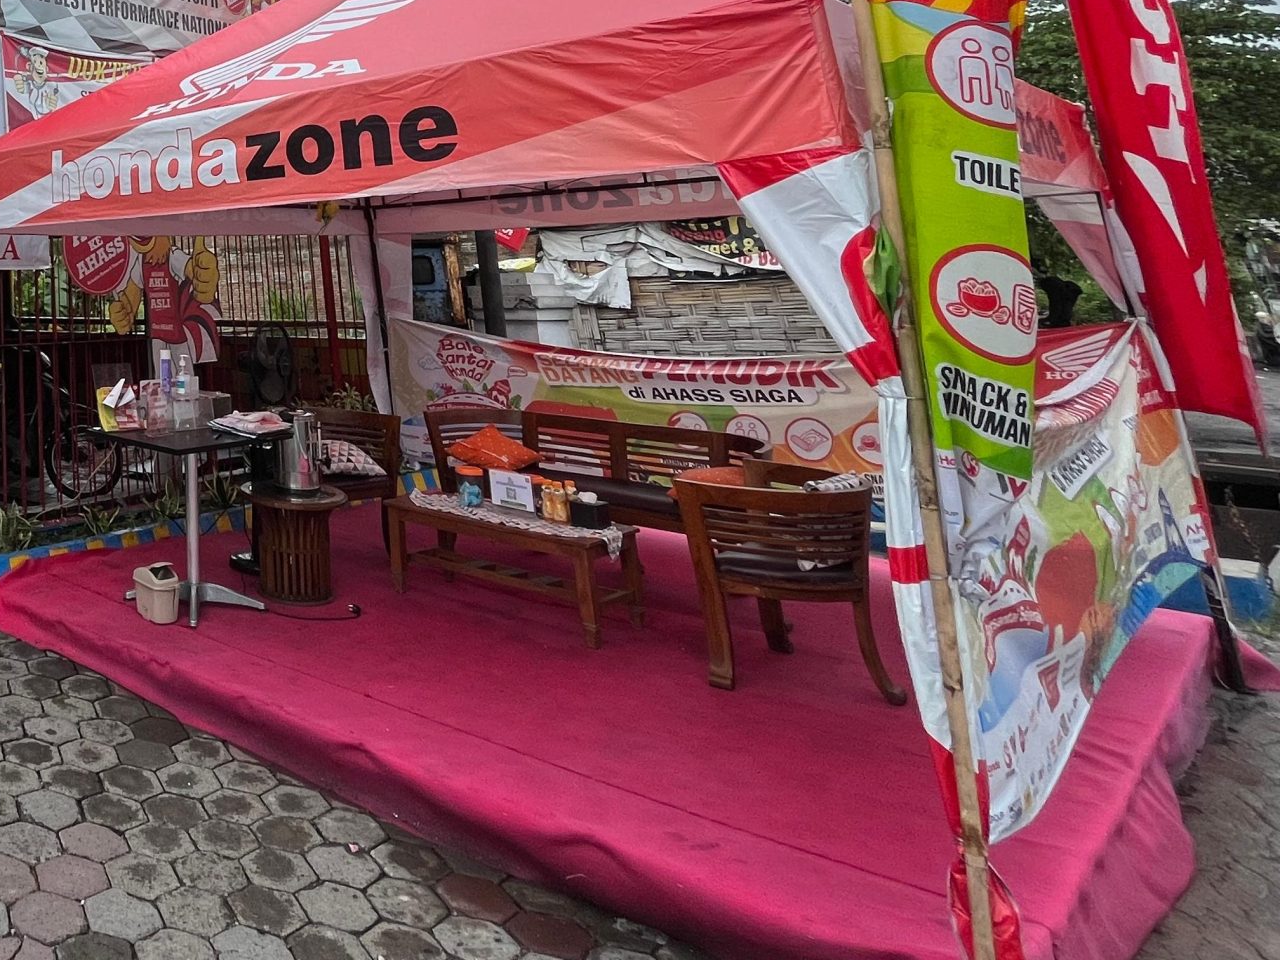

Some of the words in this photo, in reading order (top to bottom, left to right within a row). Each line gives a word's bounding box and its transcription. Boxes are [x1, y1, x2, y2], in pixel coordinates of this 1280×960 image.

[131, 58, 368, 120] HONDA
[50, 105, 459, 204] hondazone
[954, 155, 1020, 193] TOILE
[76, 237, 125, 280] AHASS
[148, 278, 169, 287] AHLI
[150, 299, 171, 308] ASLI
[436, 352, 495, 371] Santai
[445, 366, 483, 381] Honda
[541, 366, 640, 384] DATANG
[642, 359, 840, 389] PEMUDIK
[628, 386, 646, 398] di
[652, 387, 726, 402] AHASS
[729, 389, 804, 403] SIAGA
[941, 366, 1011, 413] SNACK
[1015, 392, 1027, 418] &
